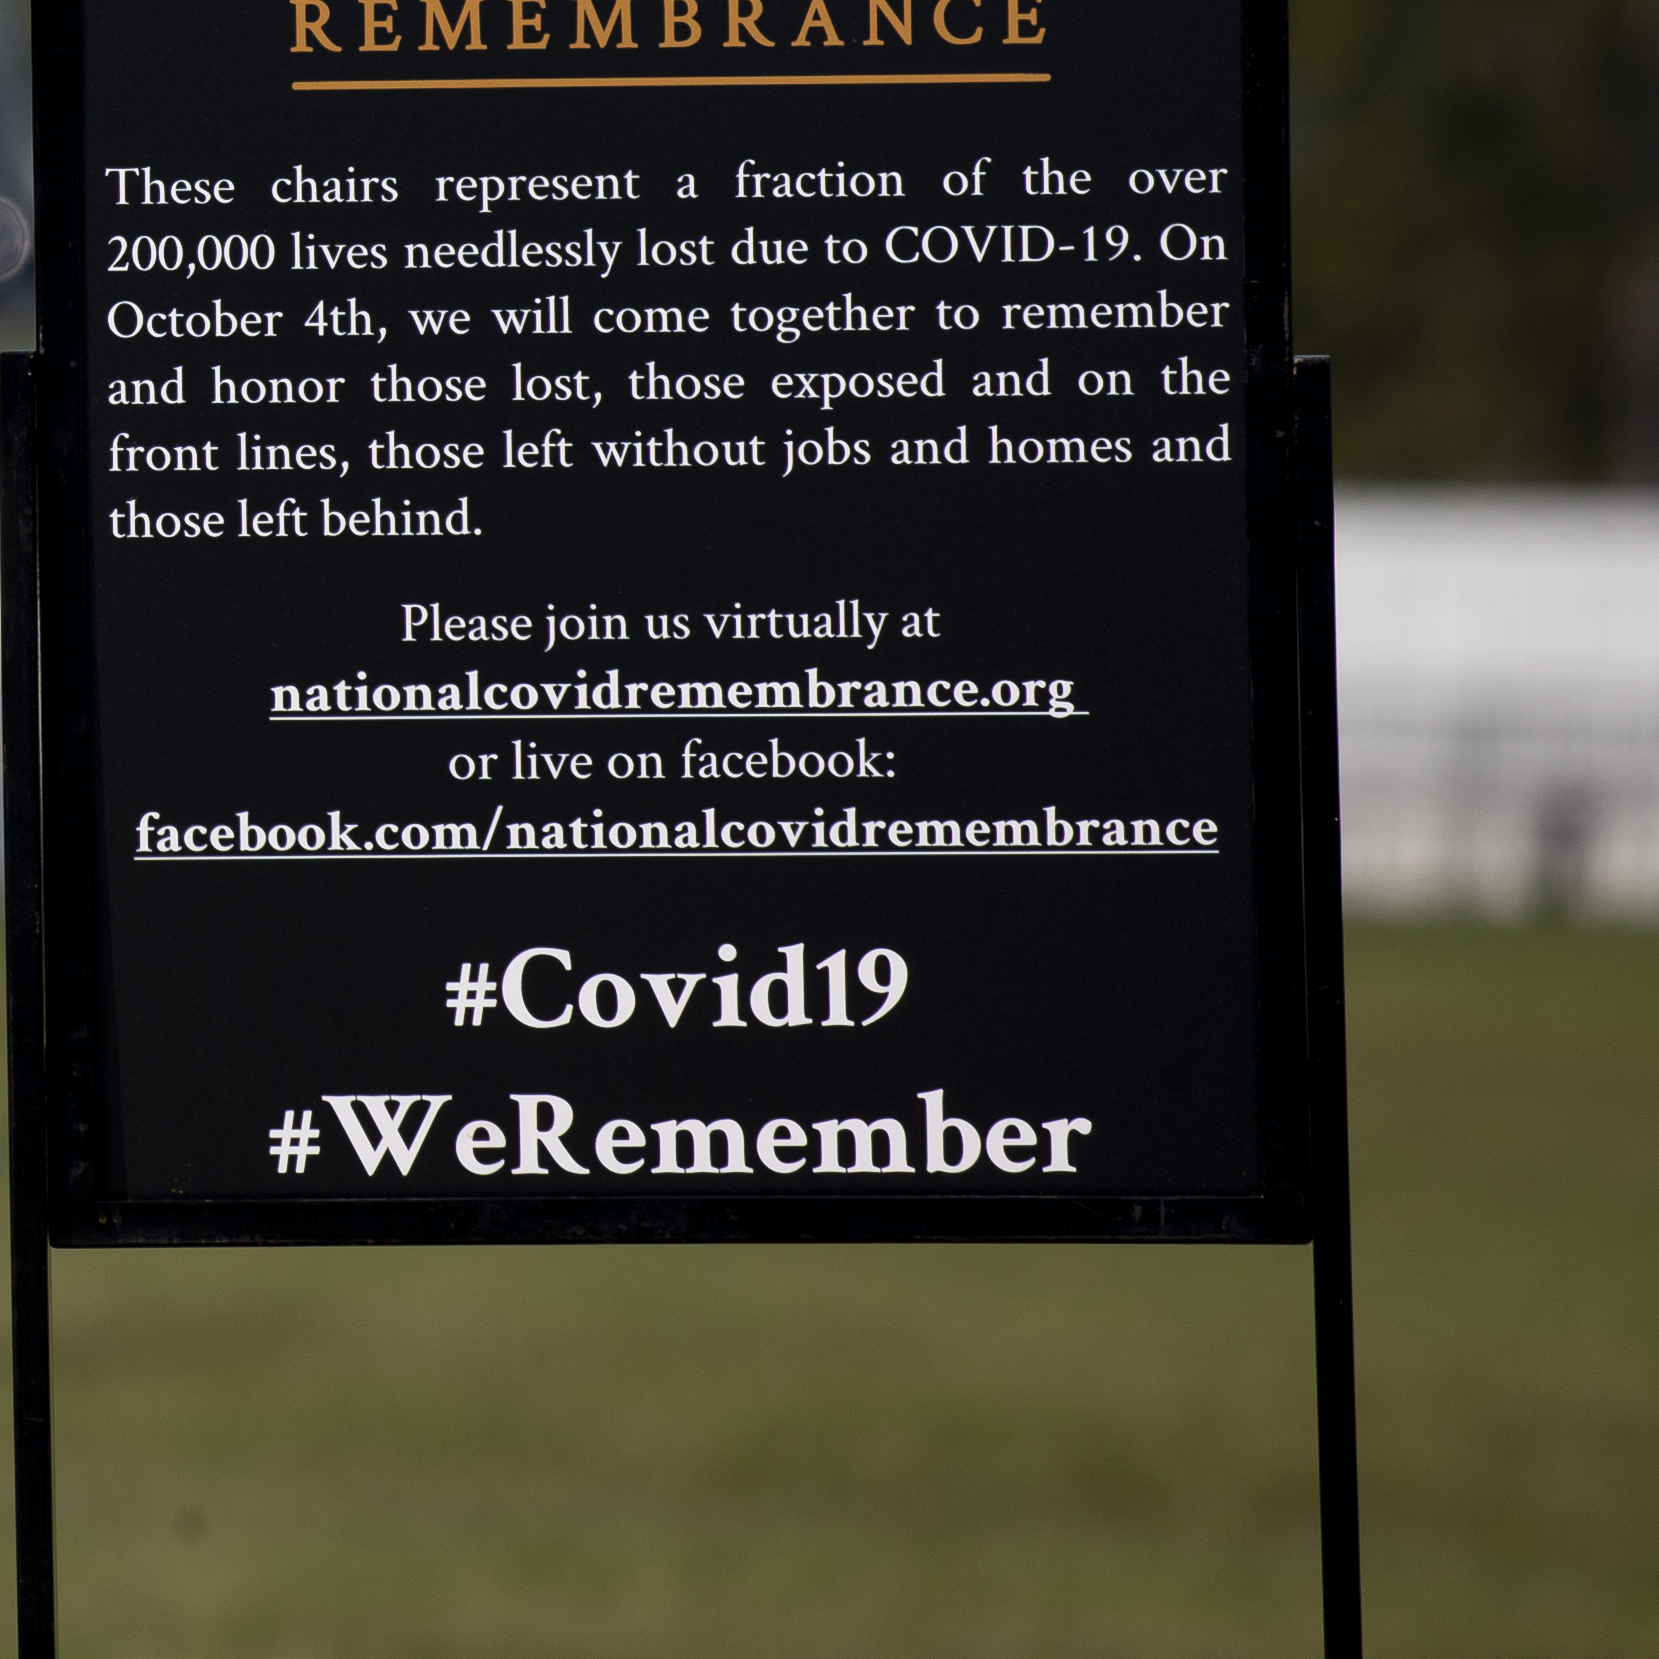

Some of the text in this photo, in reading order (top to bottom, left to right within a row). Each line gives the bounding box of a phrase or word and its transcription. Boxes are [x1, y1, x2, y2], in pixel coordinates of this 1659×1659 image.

[104, 156, 1229, 214] These chairs represent a fraction of the over
[107, 222, 1229, 280] 200,000 lives needlessly lost due to COVID-19. On
[107, 288, 1231, 344] October 4th, we will come together to remember
[108, 355, 1231, 411] and honor those lost, those exposed and on the
[108, 422, 1232, 479] front lines, those left without jobs and homes and
[108, 495, 482, 539] those left behind.
[400, 598, 941, 653] Please join us virtually at
[268, 667, 1075, 721] nationalcovidremembrance.org
[448, 736, 896, 781] or live on facebook:
[133, 804, 1220, 854] facebook.com/nationalcovidremembrance
[445, 942, 909, 1029] #Covid19
[268, 1087, 1093, 1177] #WeRemember
